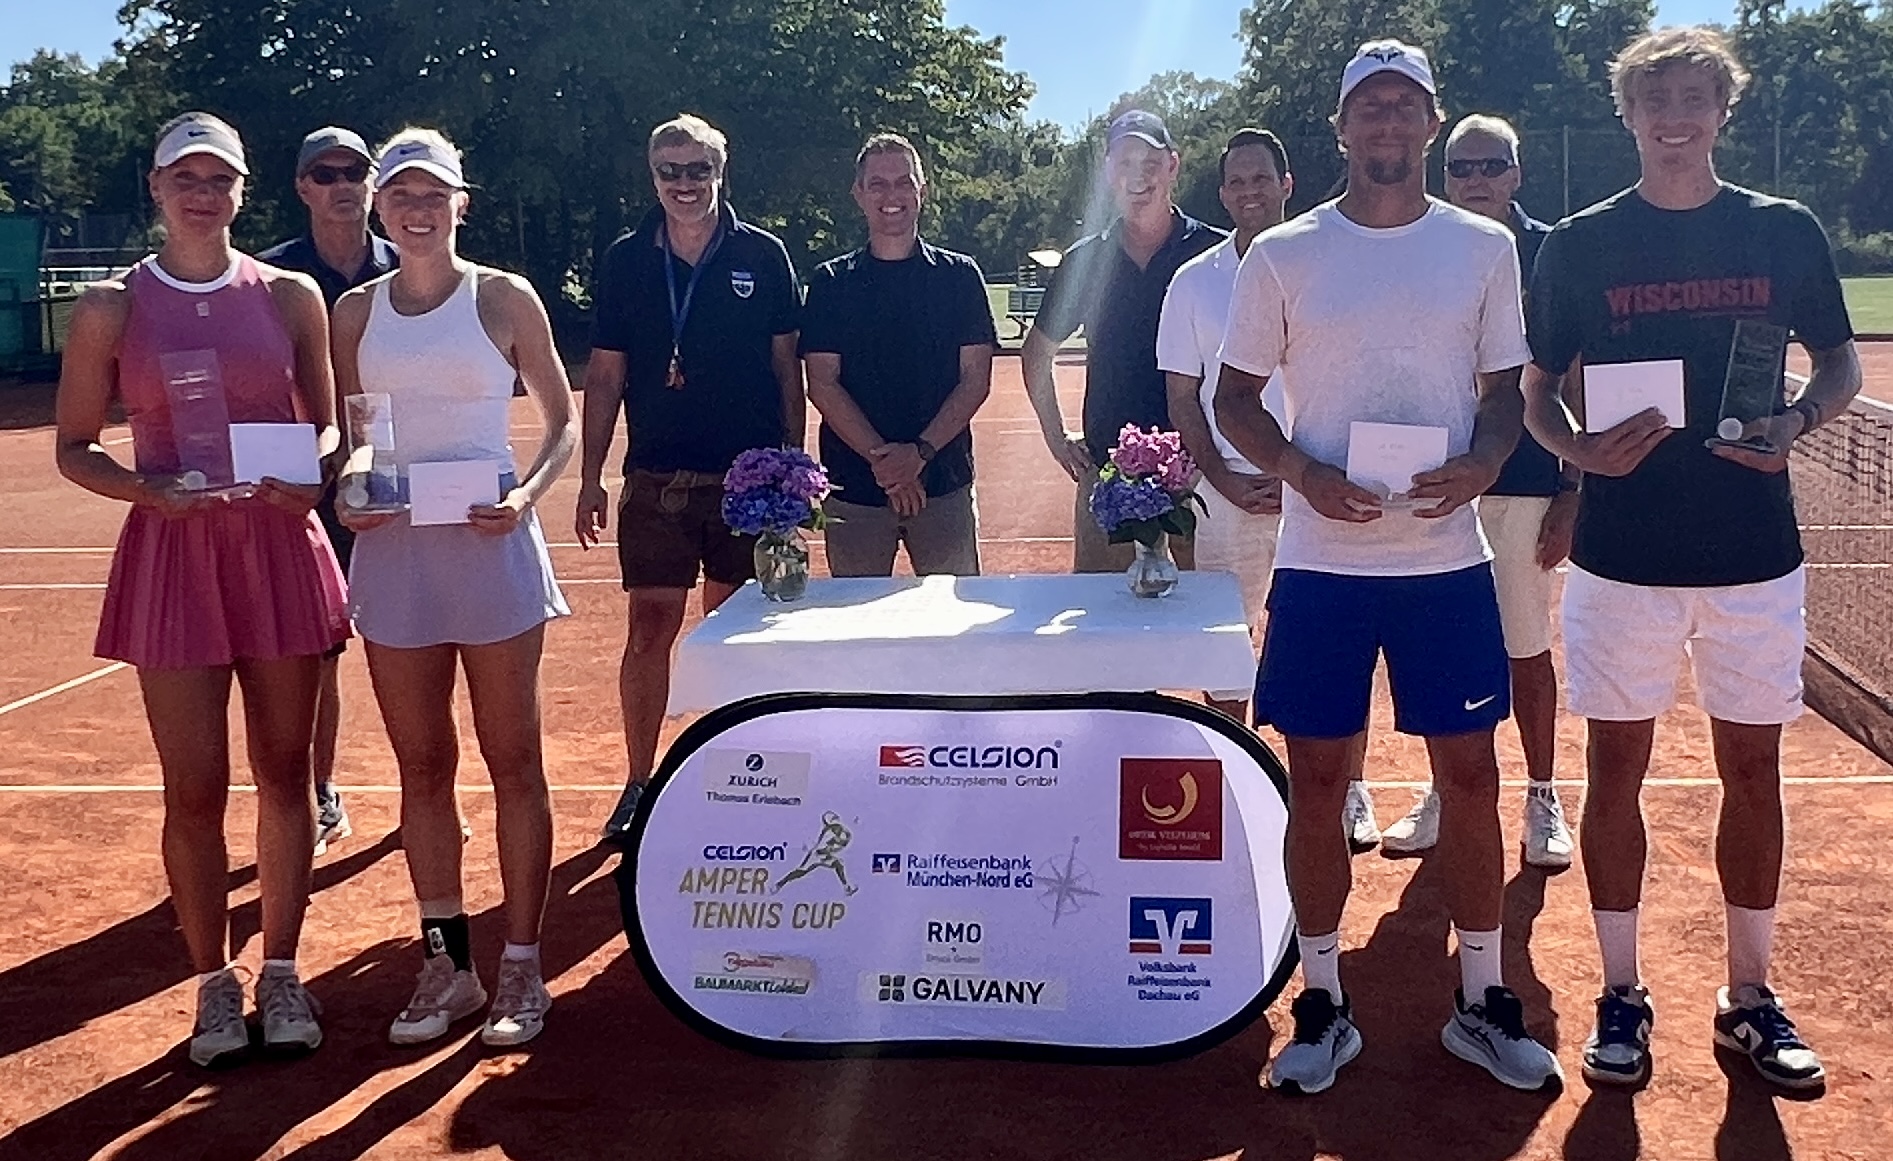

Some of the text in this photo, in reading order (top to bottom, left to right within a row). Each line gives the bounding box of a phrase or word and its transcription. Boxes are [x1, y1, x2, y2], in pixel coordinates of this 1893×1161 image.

[1604, 277, 1770, 317] WISCONSIN
[929, 746, 1059, 769] CELSION
[728, 775, 778, 787] ZURICH
[1015, 775, 1058, 787] GmbH
[703, 845, 784, 861] CELSION
[907, 854, 1032, 870] Raiffeisenbank
[678, 867, 769, 895] AMPER
[907, 872, 1033, 888] München-Nord eG
[692, 901, 845, 929] TENNIS CUP
[927, 921, 982, 943] RMO
[1138, 961, 1197, 973] Volksbank
[912, 977, 1046, 1005] GALVANY
[1137, 989, 1200, 1001] Dachau eG
